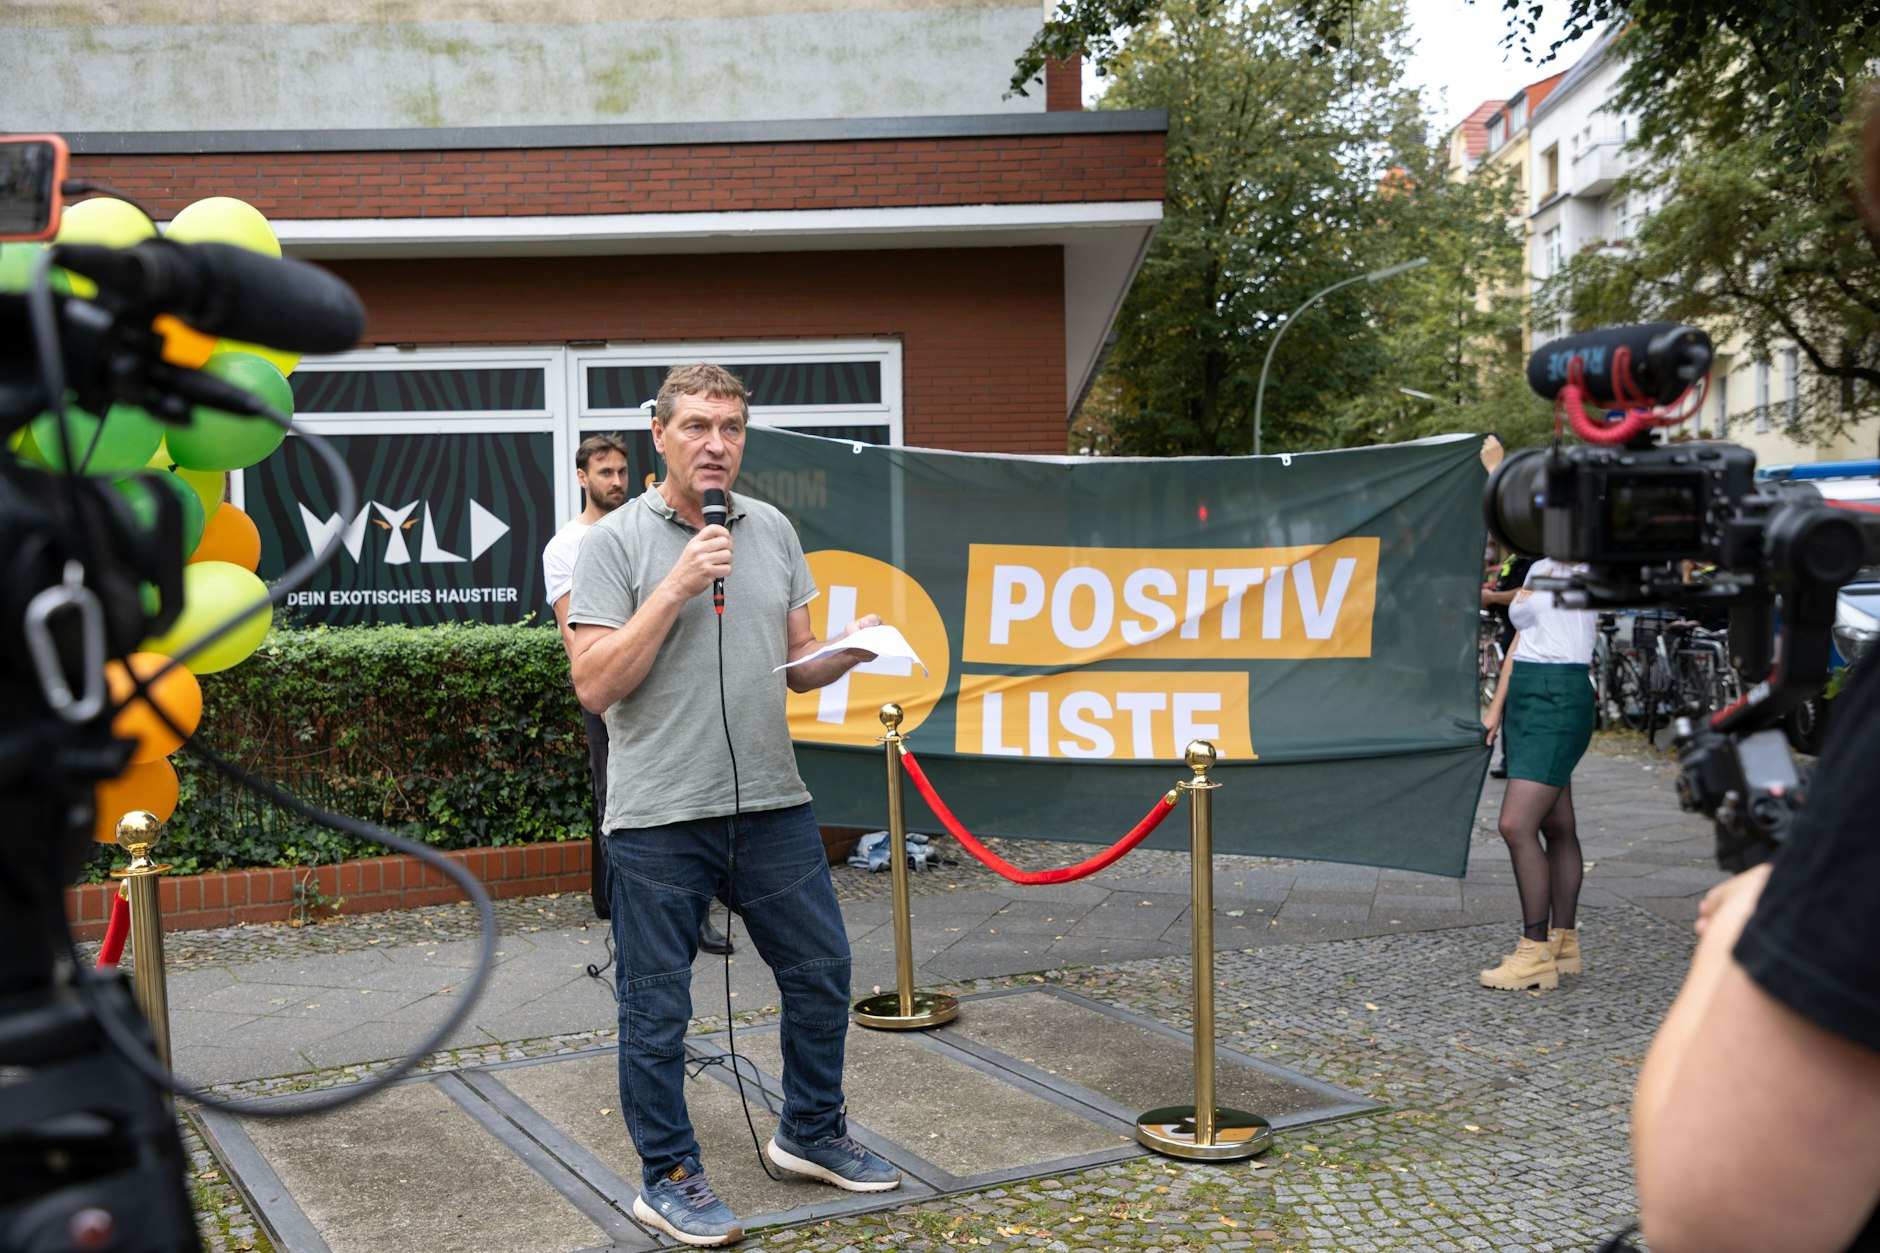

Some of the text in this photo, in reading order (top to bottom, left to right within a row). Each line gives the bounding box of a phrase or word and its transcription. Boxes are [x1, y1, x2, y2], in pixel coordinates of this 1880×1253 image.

[298, 498, 511, 564] WYLD
[287, 587, 518, 606] DEIN EXOTISCHES HAUSTIER
[989, 558, 1357, 649] POSITIV
[982, 691, 1225, 759] LISTE
